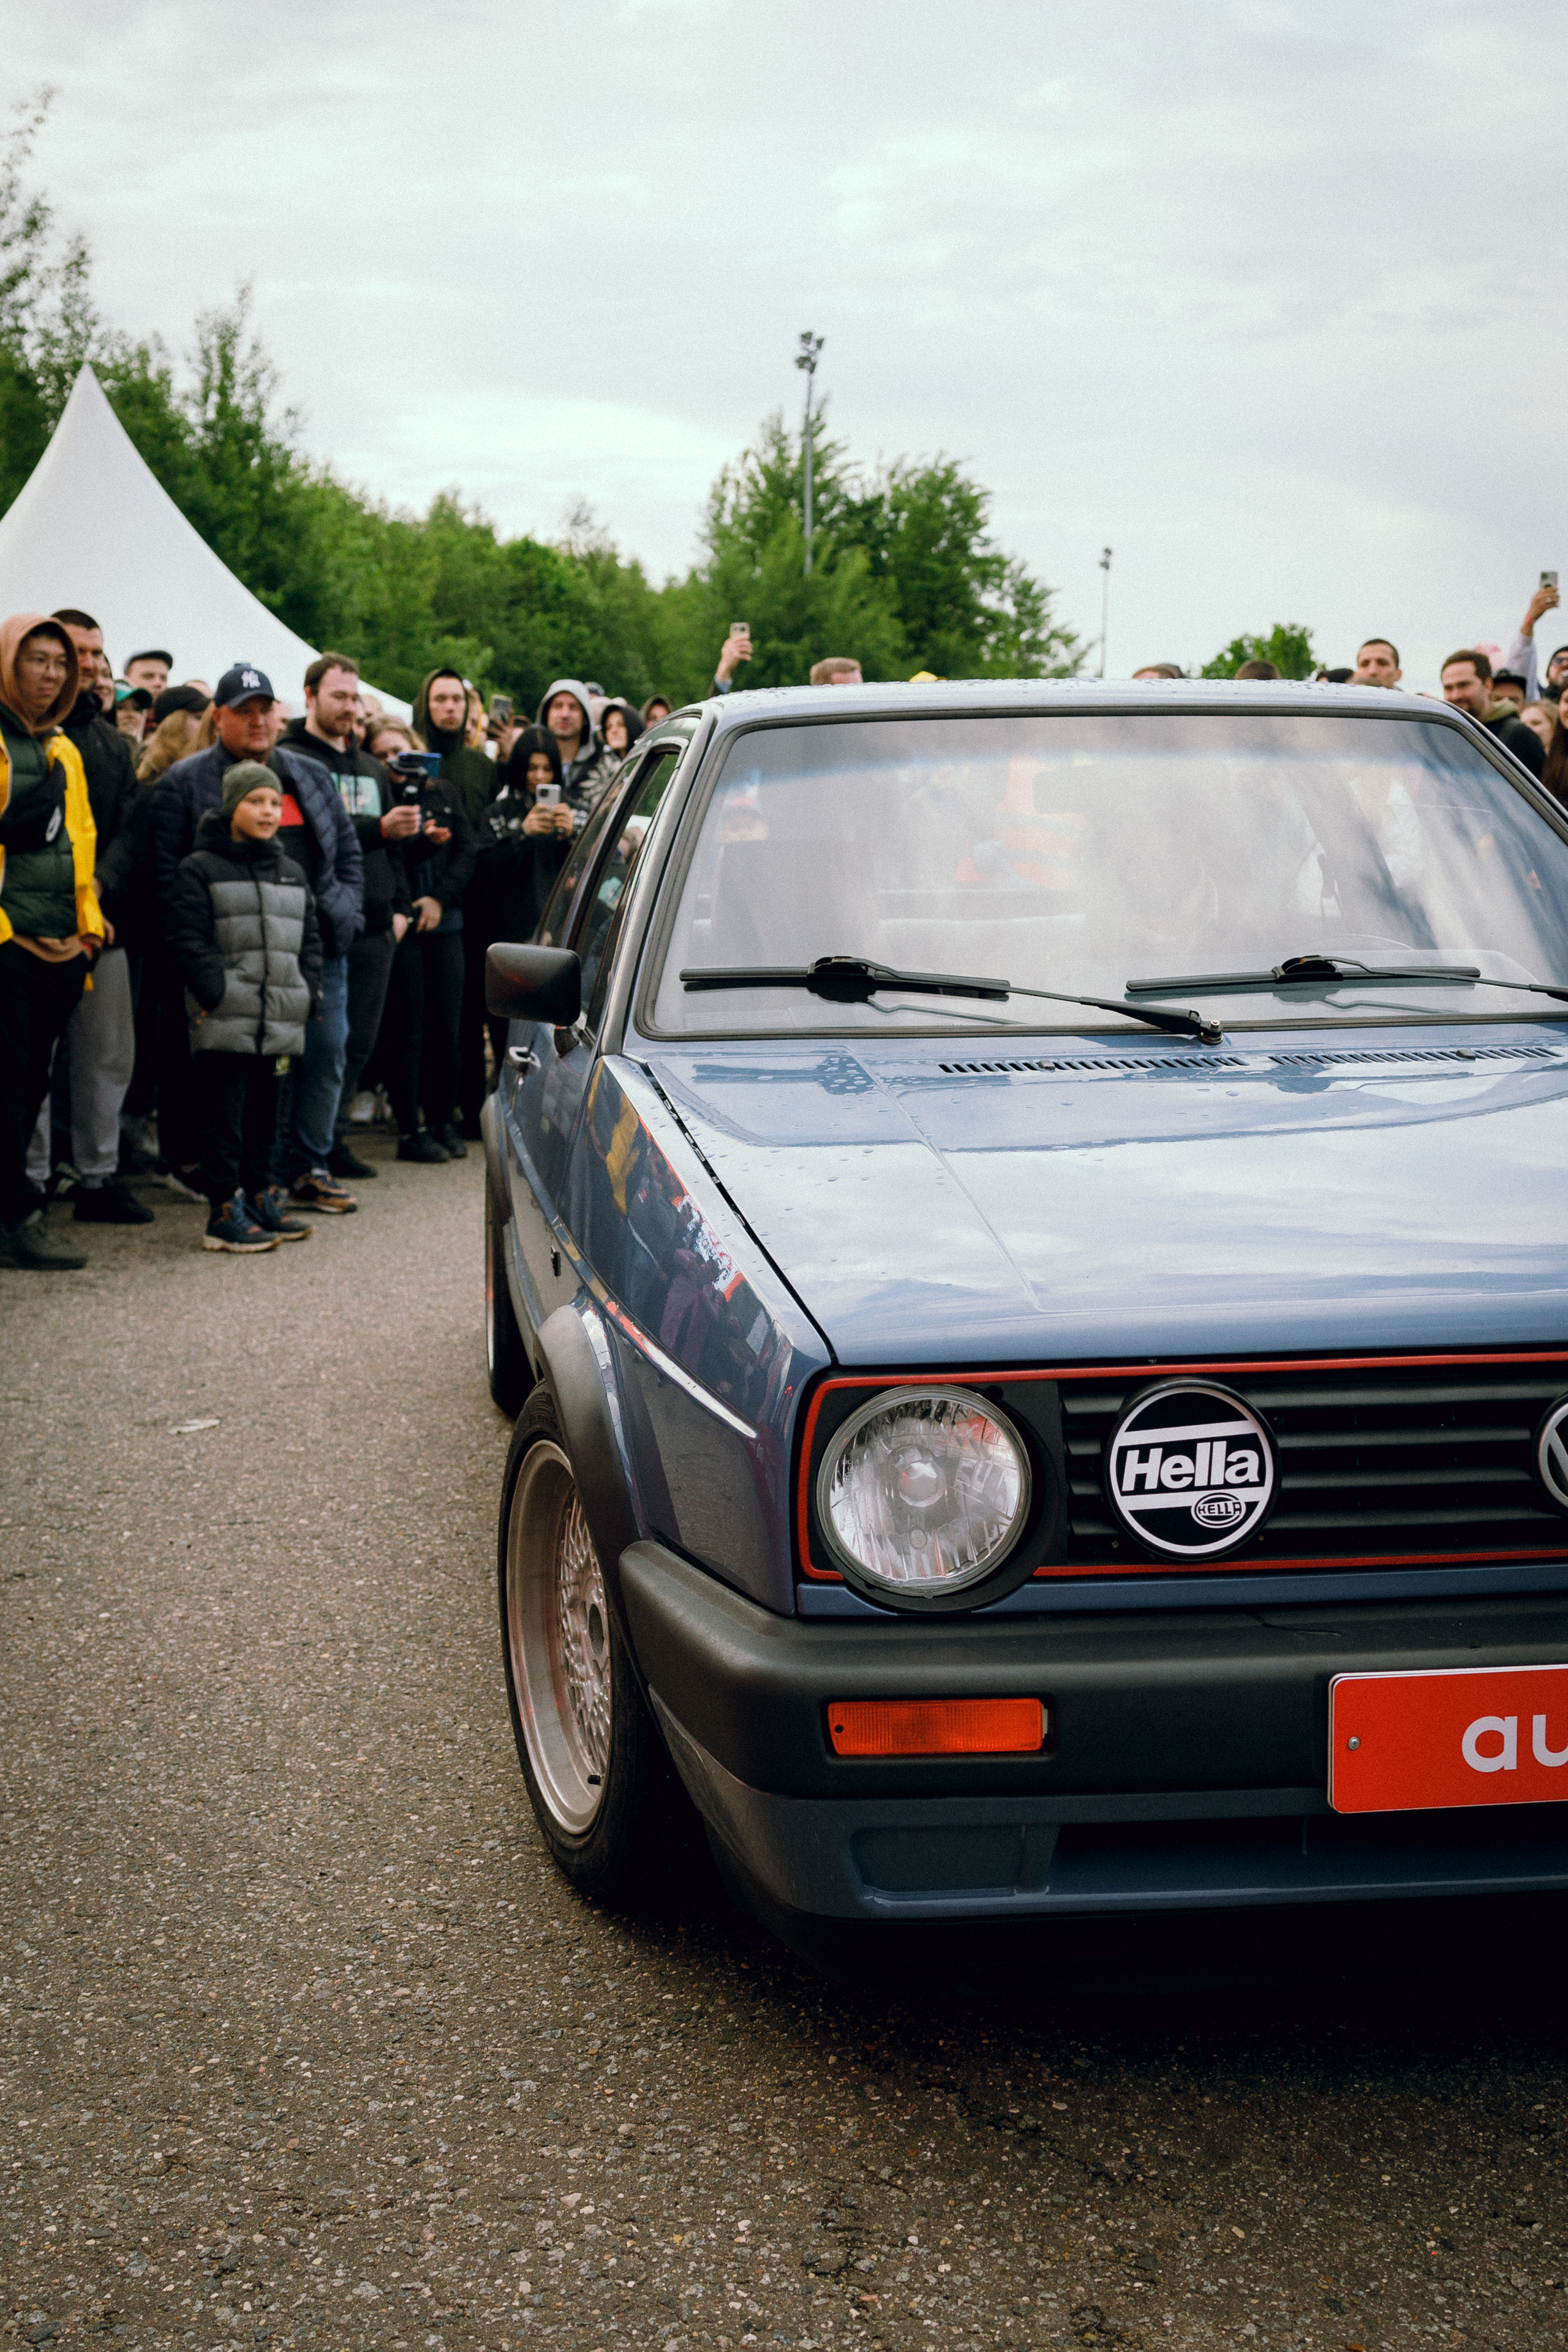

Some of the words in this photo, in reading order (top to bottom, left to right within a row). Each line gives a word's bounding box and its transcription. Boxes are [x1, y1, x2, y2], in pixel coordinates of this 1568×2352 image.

[1121, 1441, 1259, 1491] Hella
[1198, 1502, 1242, 1515] HELLA
[1462, 1714, 1568, 1773] au
